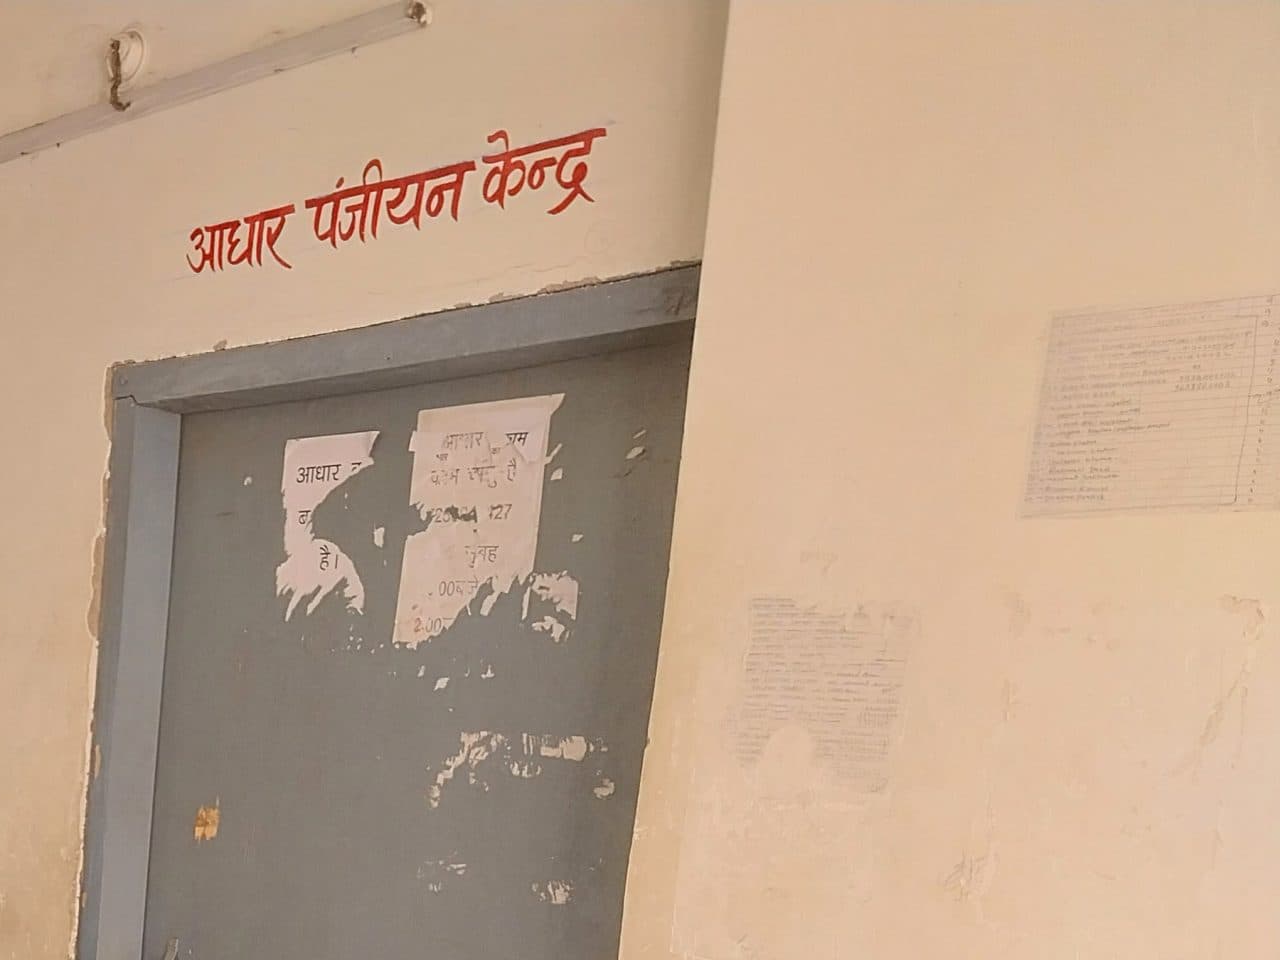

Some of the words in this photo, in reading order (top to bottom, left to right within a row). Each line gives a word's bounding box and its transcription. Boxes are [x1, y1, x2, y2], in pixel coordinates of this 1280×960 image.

[186, 204, 295, 273] आधार
[305, 158, 476, 248] पंजीयन
[482, 128, 606, 215] केन्द्र
[296, 463, 342, 484] आधार
